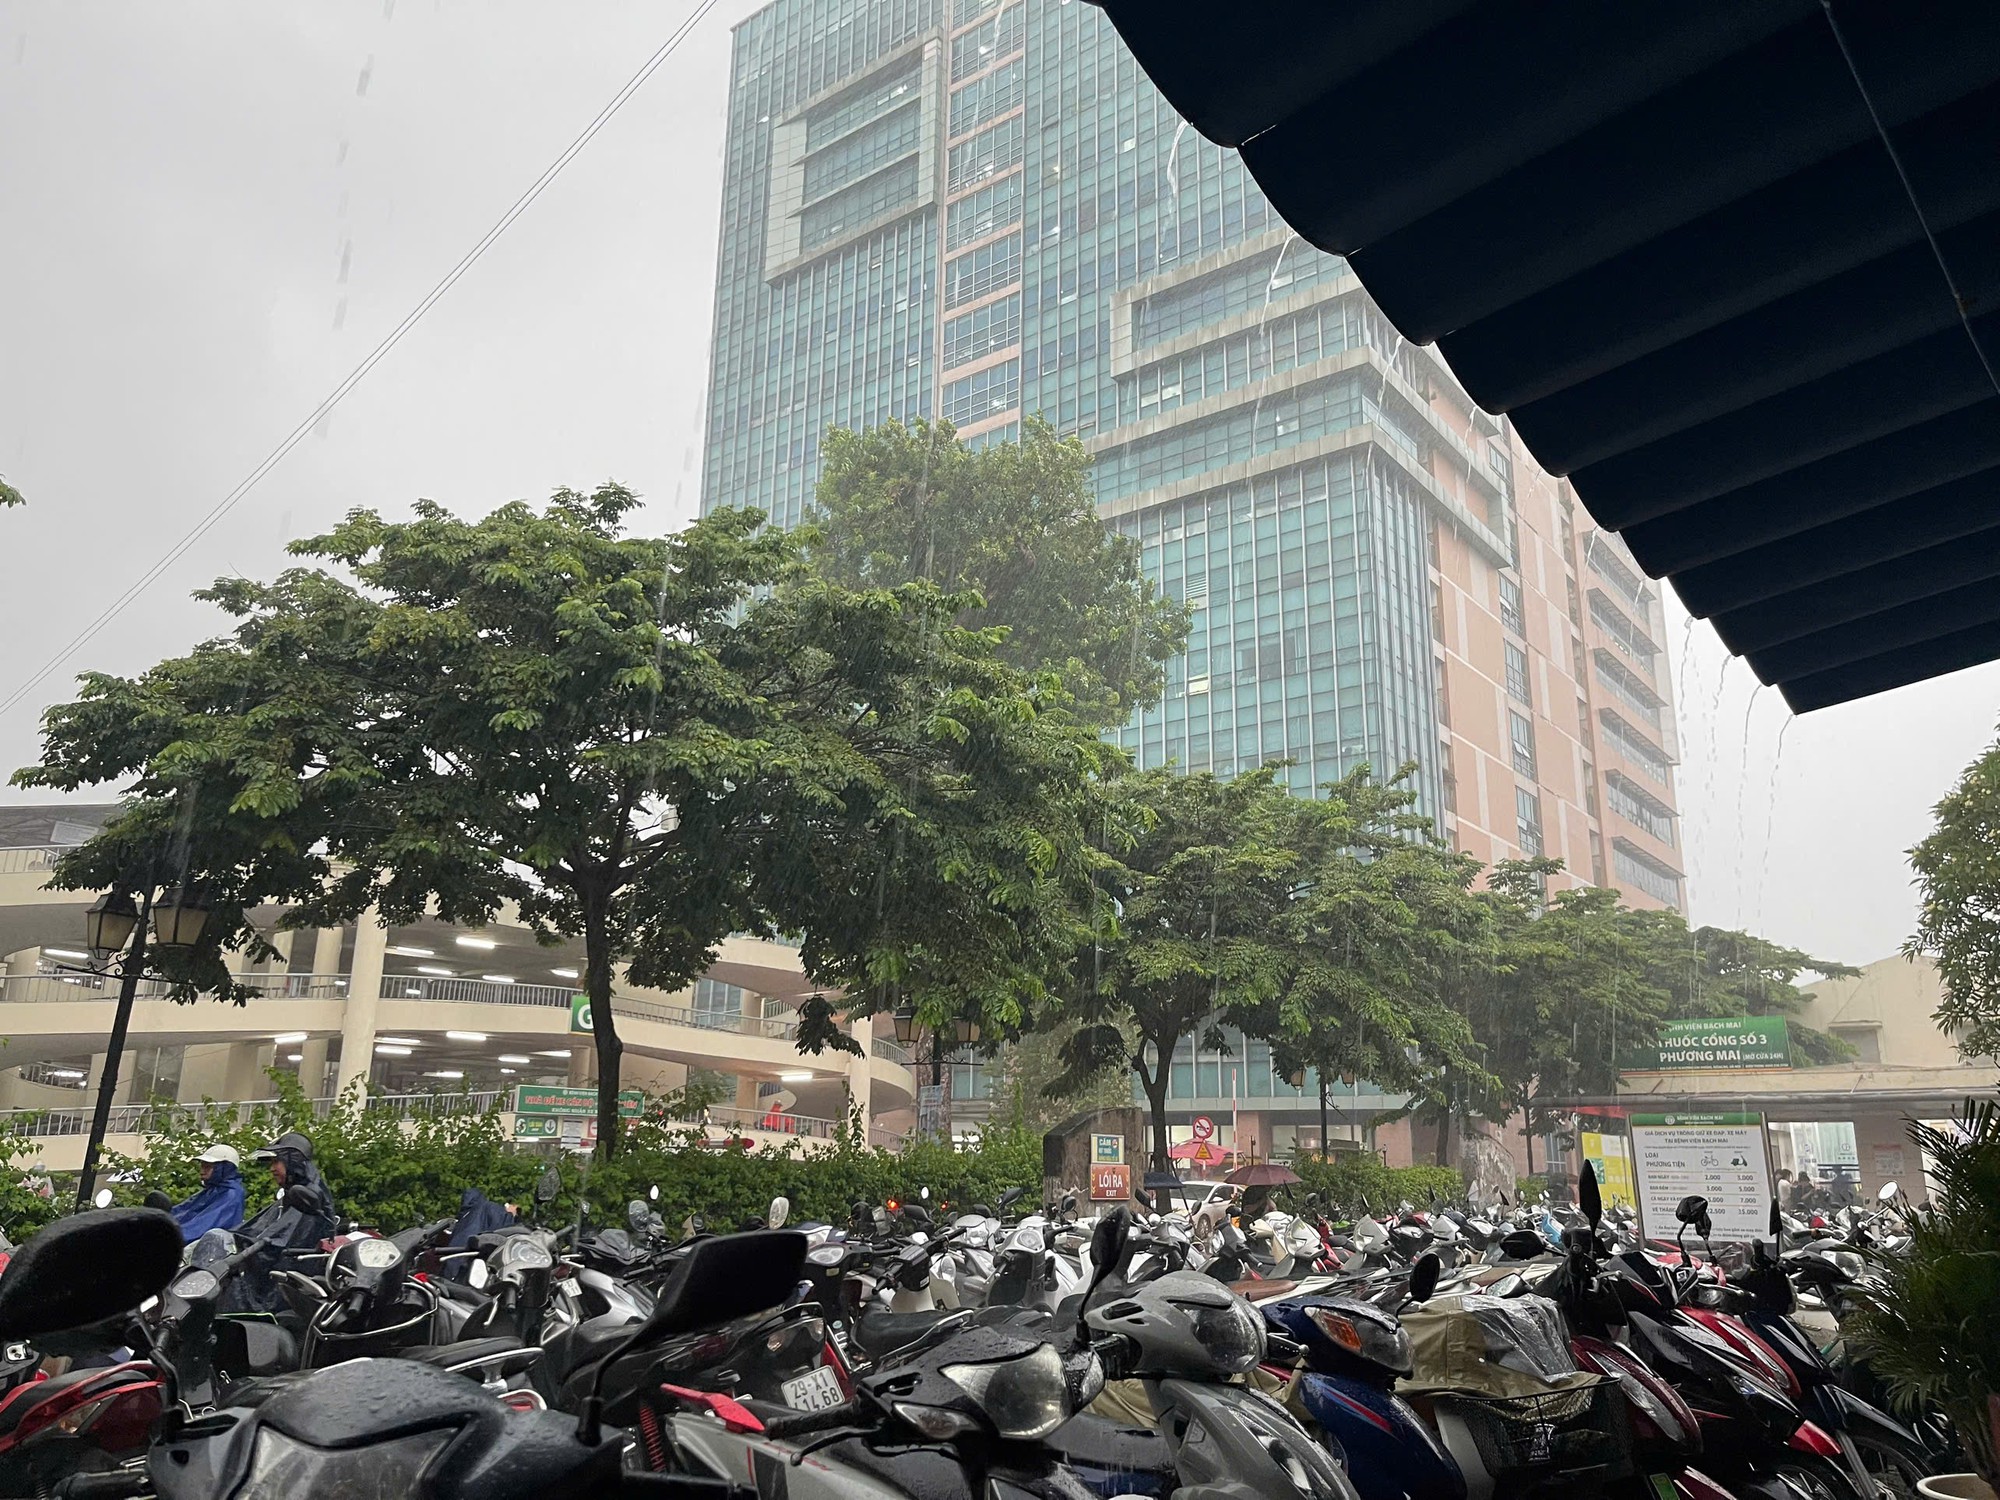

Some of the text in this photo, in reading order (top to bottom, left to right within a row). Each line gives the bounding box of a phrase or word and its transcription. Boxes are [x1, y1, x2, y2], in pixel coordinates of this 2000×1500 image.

[1726, 1021, 1741, 1029] MAI
[1739, 1031, 1757, 1045] SỐ
[1759, 1034, 1767, 1045] 3
[1660, 1050, 1714, 1062] PHƯƠNG
[1716, 1050, 1740, 1060] MAI
[1099, 1169, 1123, 1188] LỐI RA
[1105, 1189, 1117, 1197] EXIT
[790, 1371, 829, 1400] 29-X1
